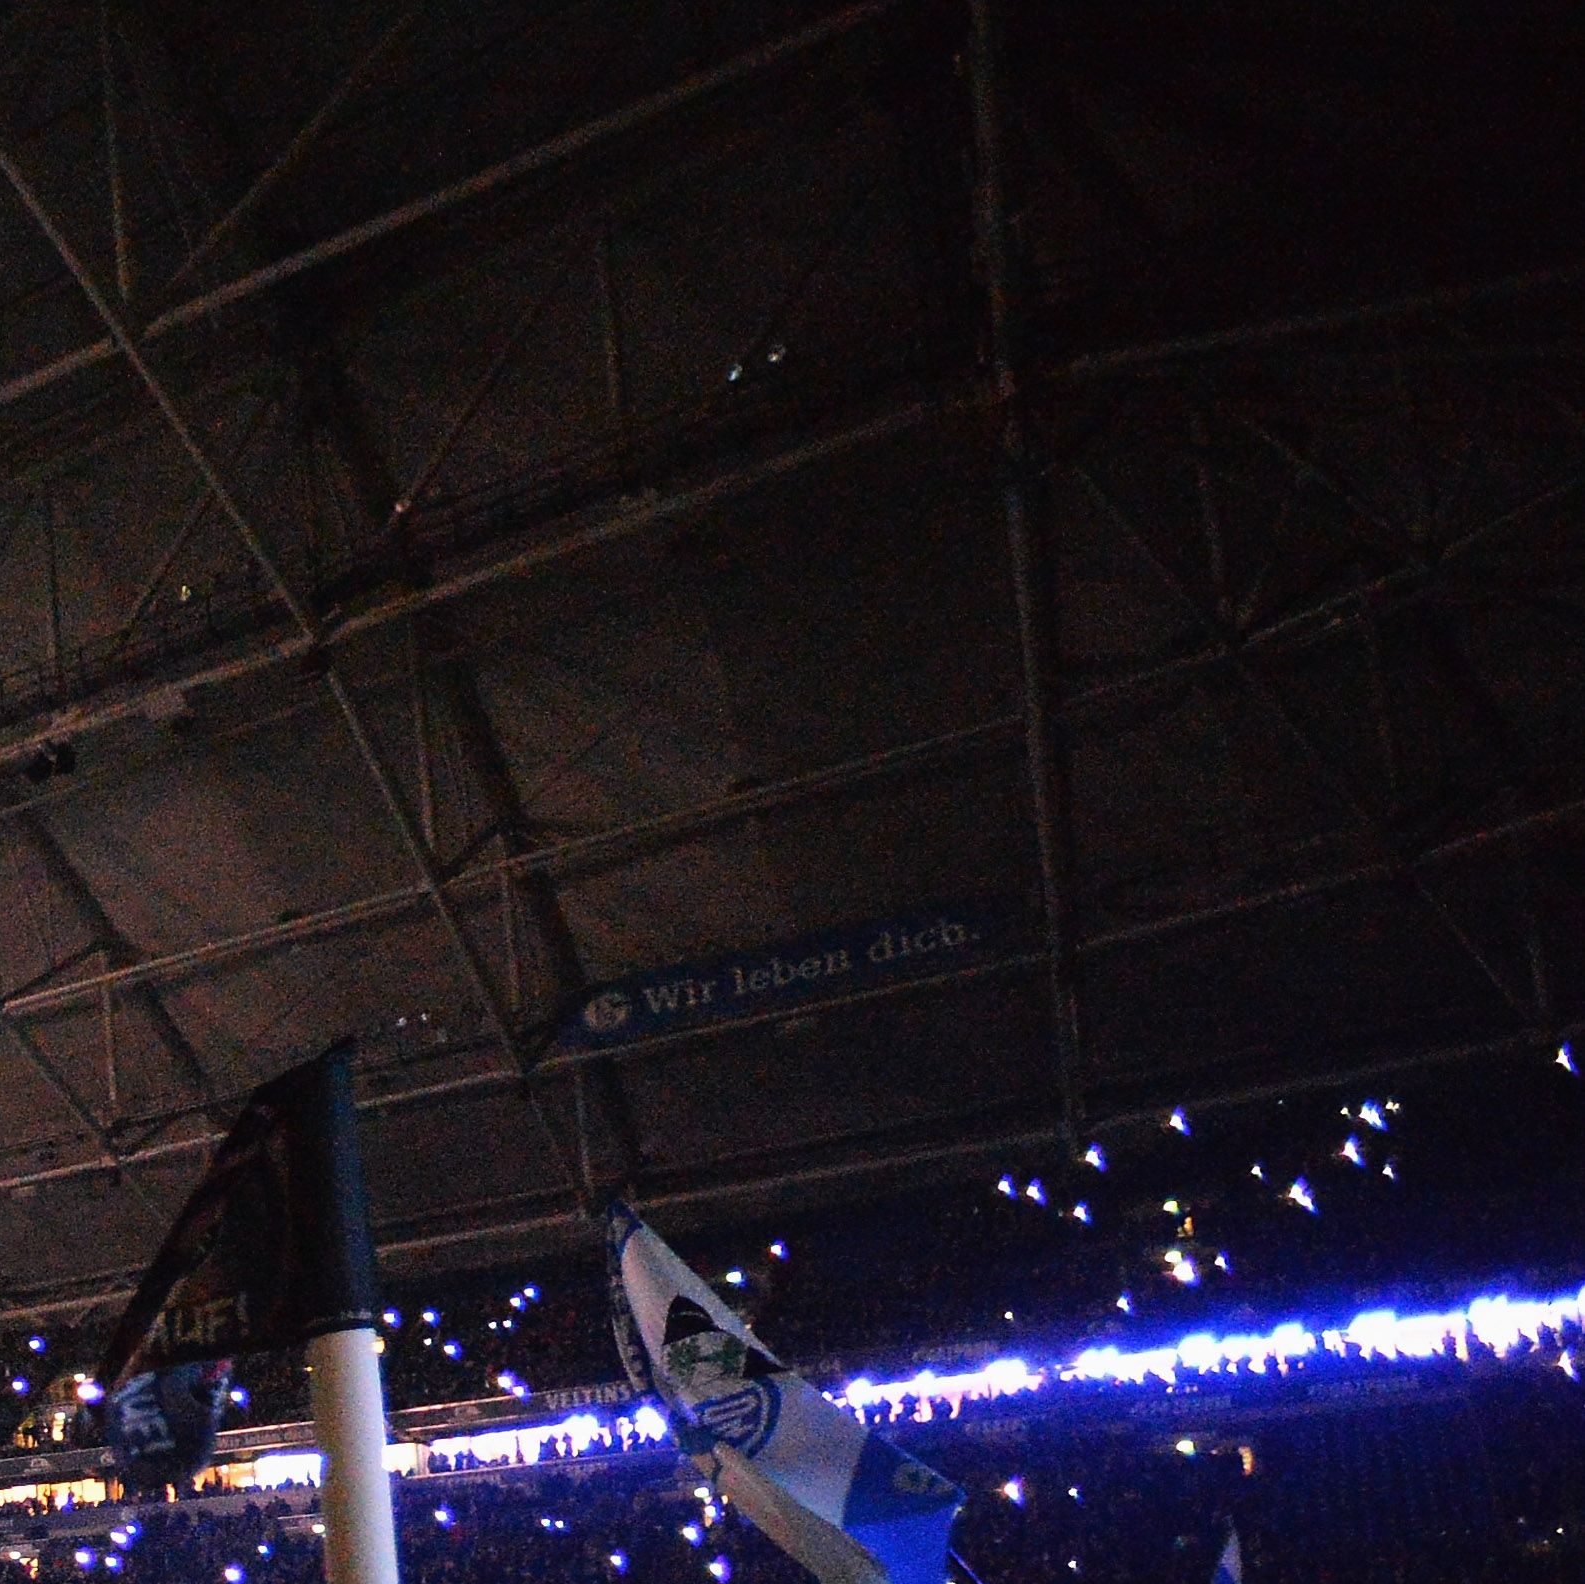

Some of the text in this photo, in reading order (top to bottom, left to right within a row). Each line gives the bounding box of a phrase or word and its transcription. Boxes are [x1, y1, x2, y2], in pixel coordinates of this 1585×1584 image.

[642, 976, 718, 1014] Wir
[732, 946, 854, 996] leben
[546, 1382, 631, 1410] VELTINS
